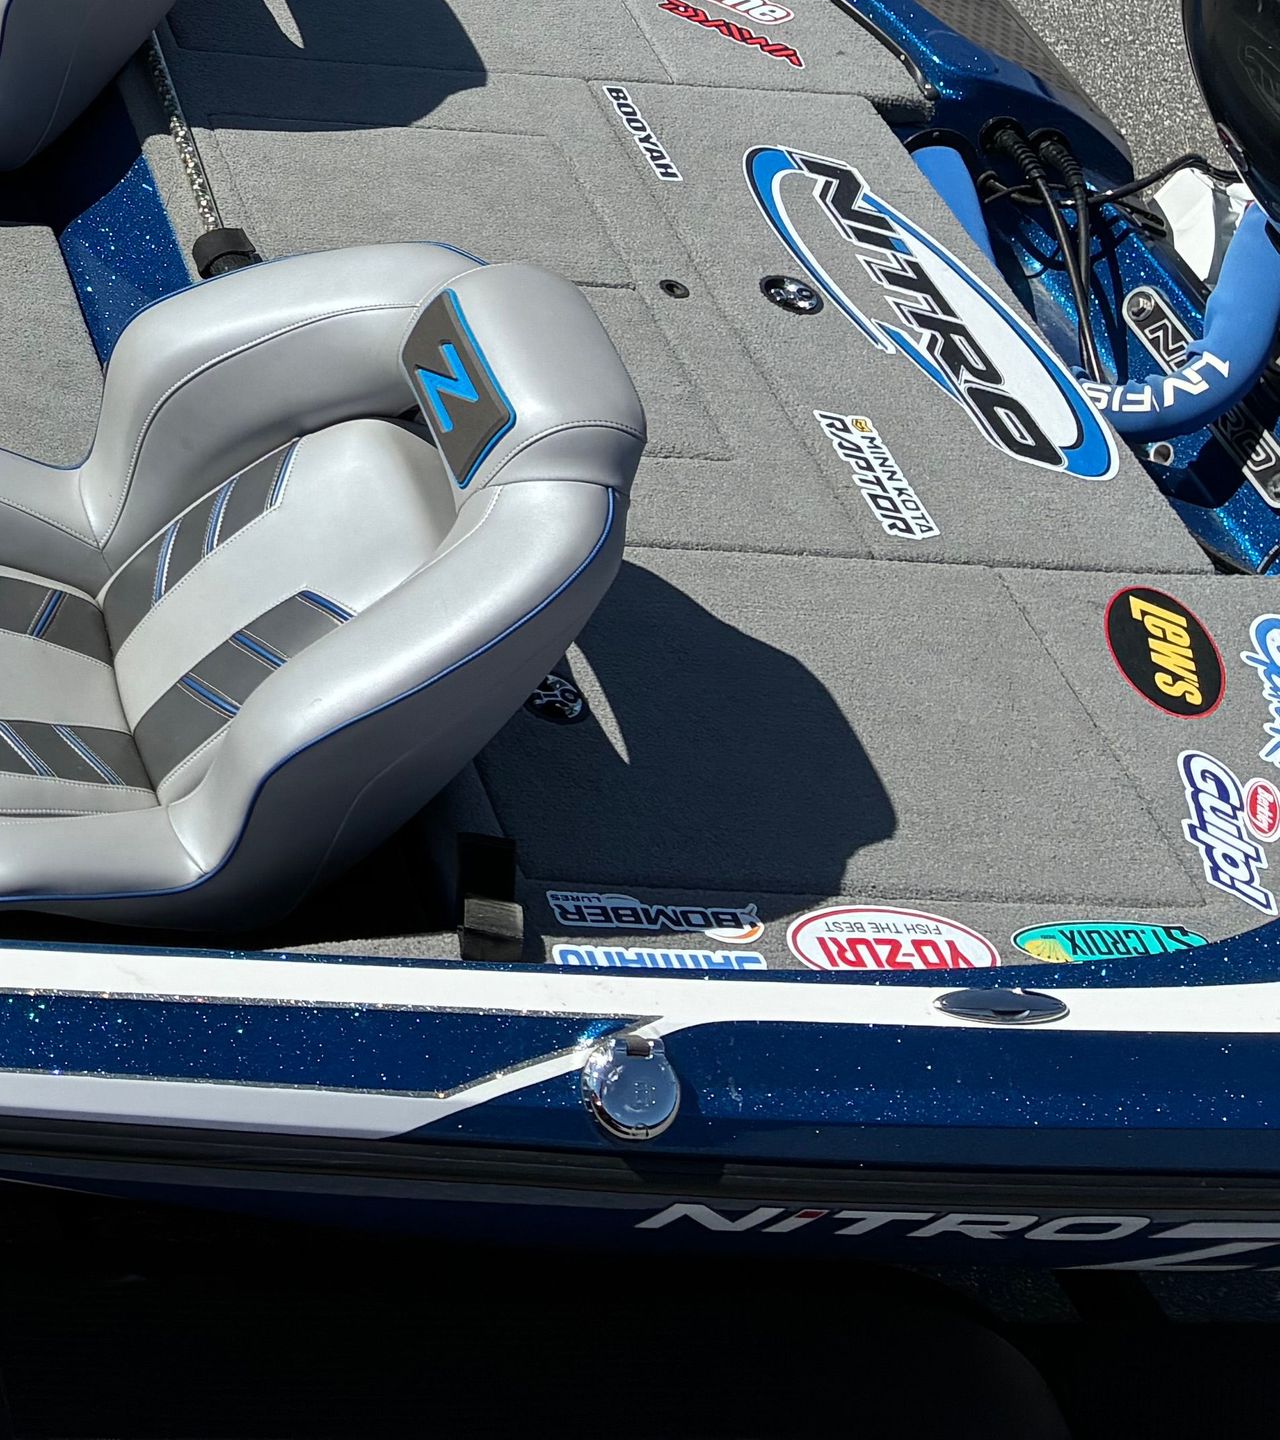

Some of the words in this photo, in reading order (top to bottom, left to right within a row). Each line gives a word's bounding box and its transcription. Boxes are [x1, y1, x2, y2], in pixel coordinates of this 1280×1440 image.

[606, 87, 679, 178] BOOYAH
[819, 413, 916, 536] RAPTOR
[860, 435, 903, 482] MINN
[893, 487, 934, 534] KOTA
[550, 894, 601, 903] LURES
[553, 904, 744, 930] BOMBER
[824, 921, 866, 933] BEST
[867, 922, 903, 934] THE
[907, 923, 942, 935] FISH
[815, 936, 976, 970] YO-ZURI
